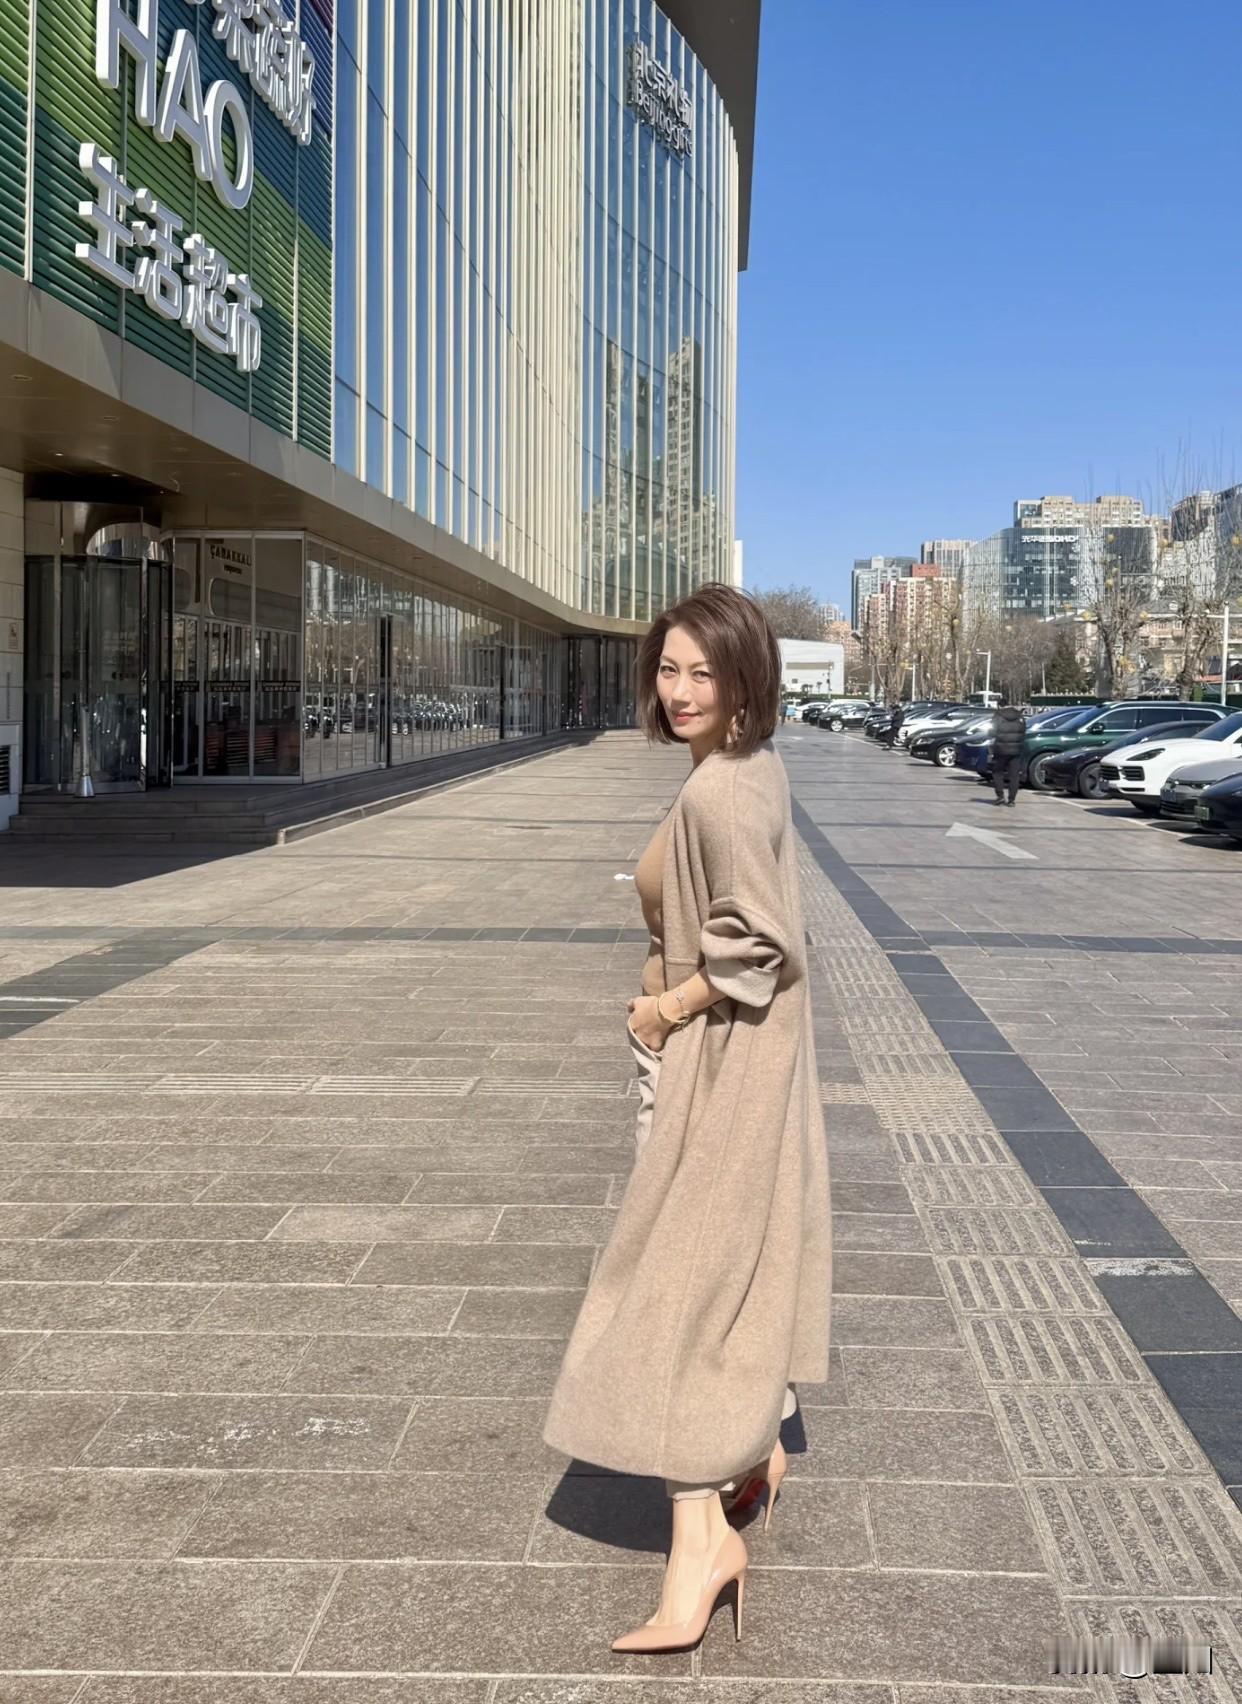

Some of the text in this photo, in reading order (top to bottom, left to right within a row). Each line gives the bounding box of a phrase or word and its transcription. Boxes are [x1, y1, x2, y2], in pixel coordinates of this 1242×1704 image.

[95, 0, 254, 210] HAO
[75, 143, 263, 373] 生活超市
